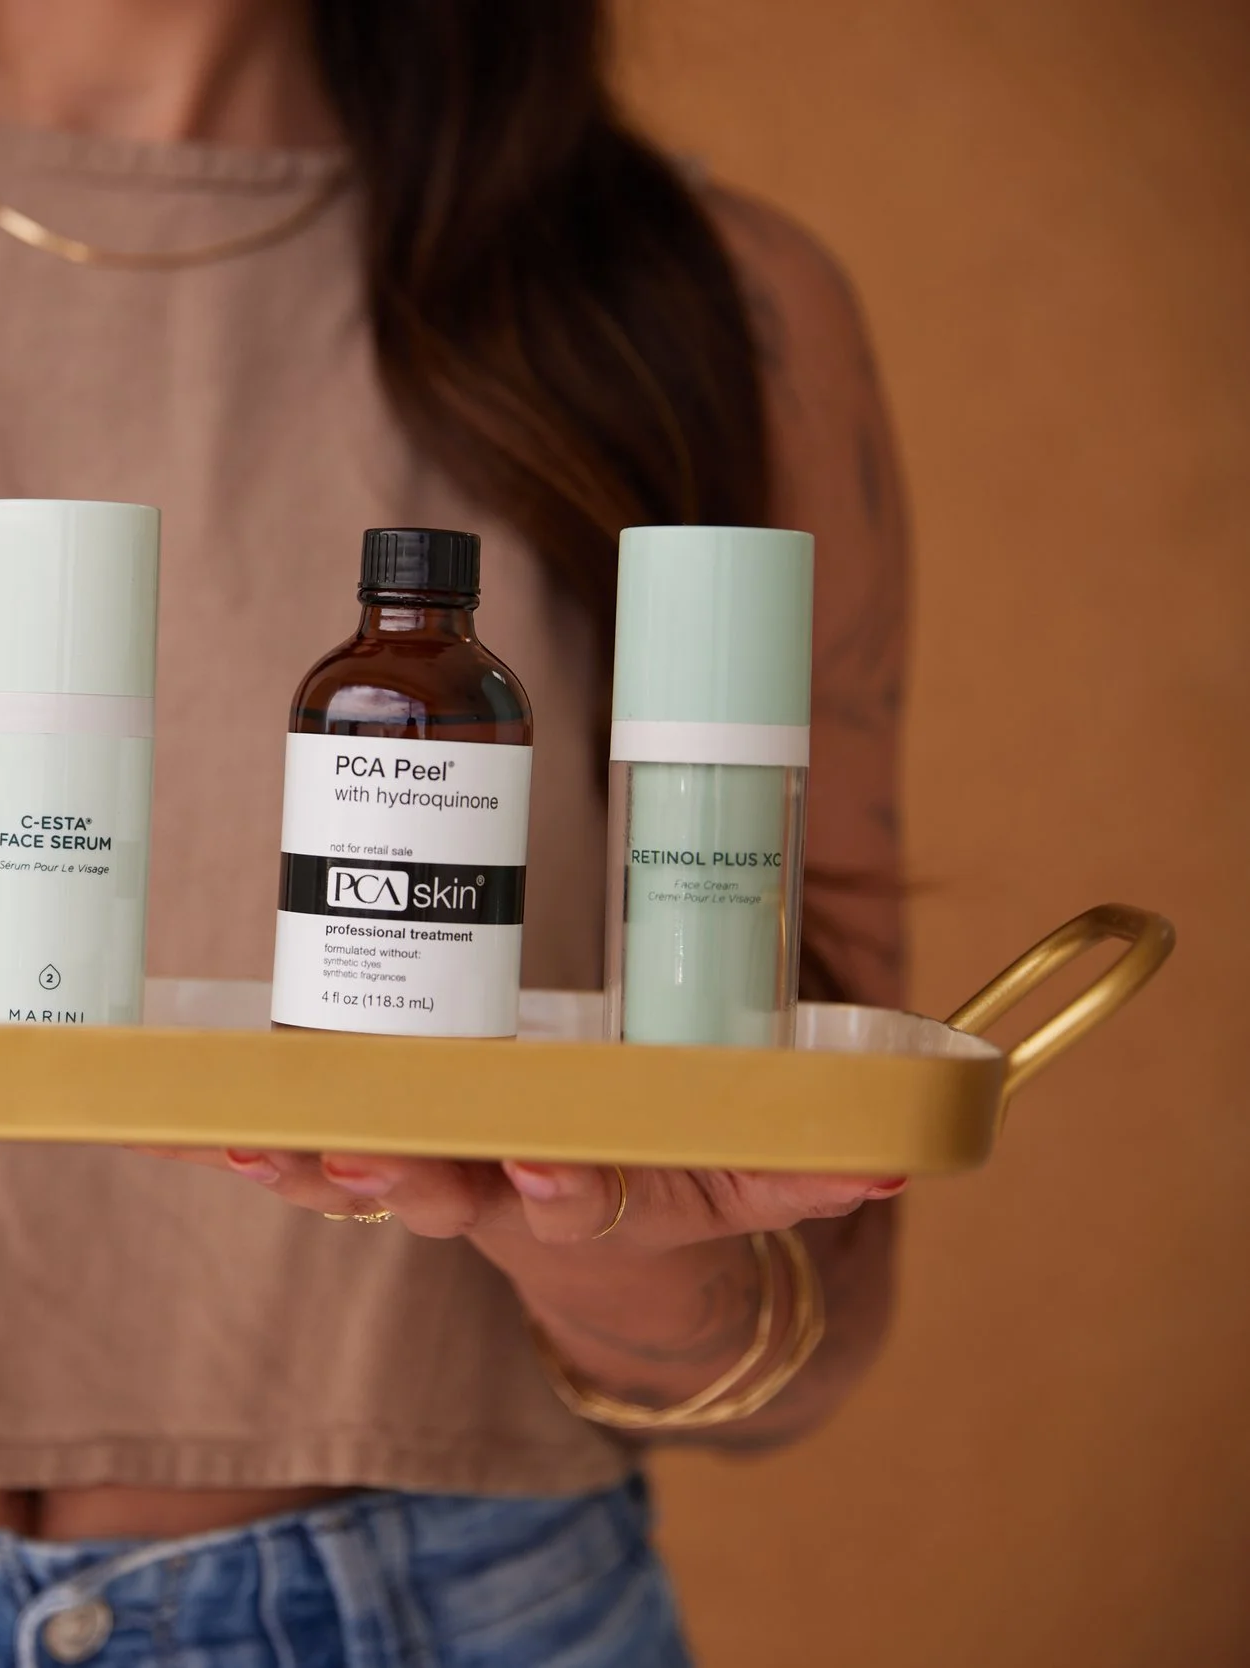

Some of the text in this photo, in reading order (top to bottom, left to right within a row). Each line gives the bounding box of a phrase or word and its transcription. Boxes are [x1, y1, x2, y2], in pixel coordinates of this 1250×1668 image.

[335, 755, 385, 778] PCA
[335, 786, 499, 811] with hydroquinone
[0, 833, 112, 851] FACE SERUM
[330, 842, 413, 857] not for retail sale
[631, 850, 782, 867] RETINOL PLUS XC
[0, 860, 109, 875] Sérum Pour Le Visage
[334, 871, 402, 906] PCA
[703, 880, 739, 890] Cream
[683, 893, 710, 903] Pour
[712, 894, 726, 903] Le
[730, 895, 762, 905] Visage
[325, 923, 473, 942] professional treatment
[324, 944, 421, 960] formulated without:
[323, 957, 381, 969] synthetic dyes
[46, 973, 53, 984] 2
[323, 968, 406, 982] synthetic fragrances
[321, 991, 434, 1013] 4 fl oz (118.3 mL)
[9, 1008, 84, 1023] MARINI
